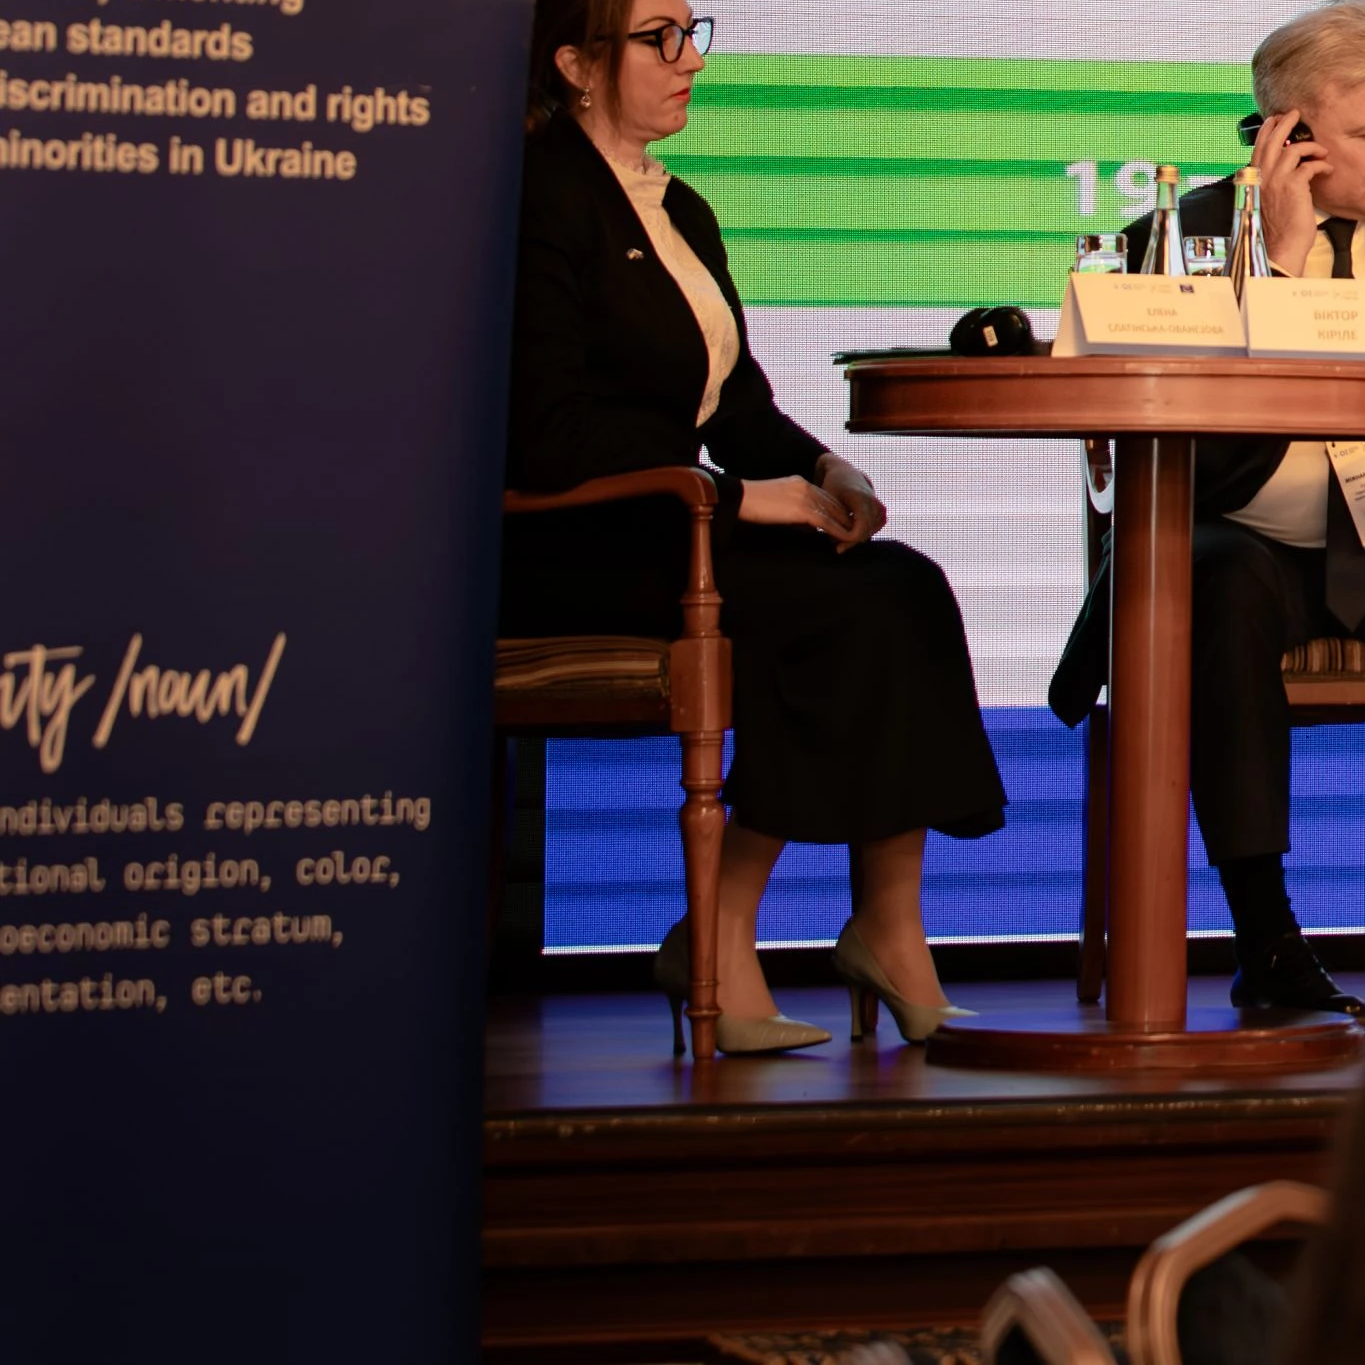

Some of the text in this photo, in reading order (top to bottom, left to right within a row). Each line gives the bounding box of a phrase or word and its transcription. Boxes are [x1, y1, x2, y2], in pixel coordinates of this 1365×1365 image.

[66, 17, 254, 61] standards
[247, 84, 316, 121] and
[327, 87, 431, 132] rights
[169, 135, 204, 175] in
[215, 137, 357, 180] Ukraine
[204, 790, 432, 834] representing
[295, 850, 401, 889] color,
[190, 913, 344, 948] stratum,
[191, 971, 263, 1005] etc.
